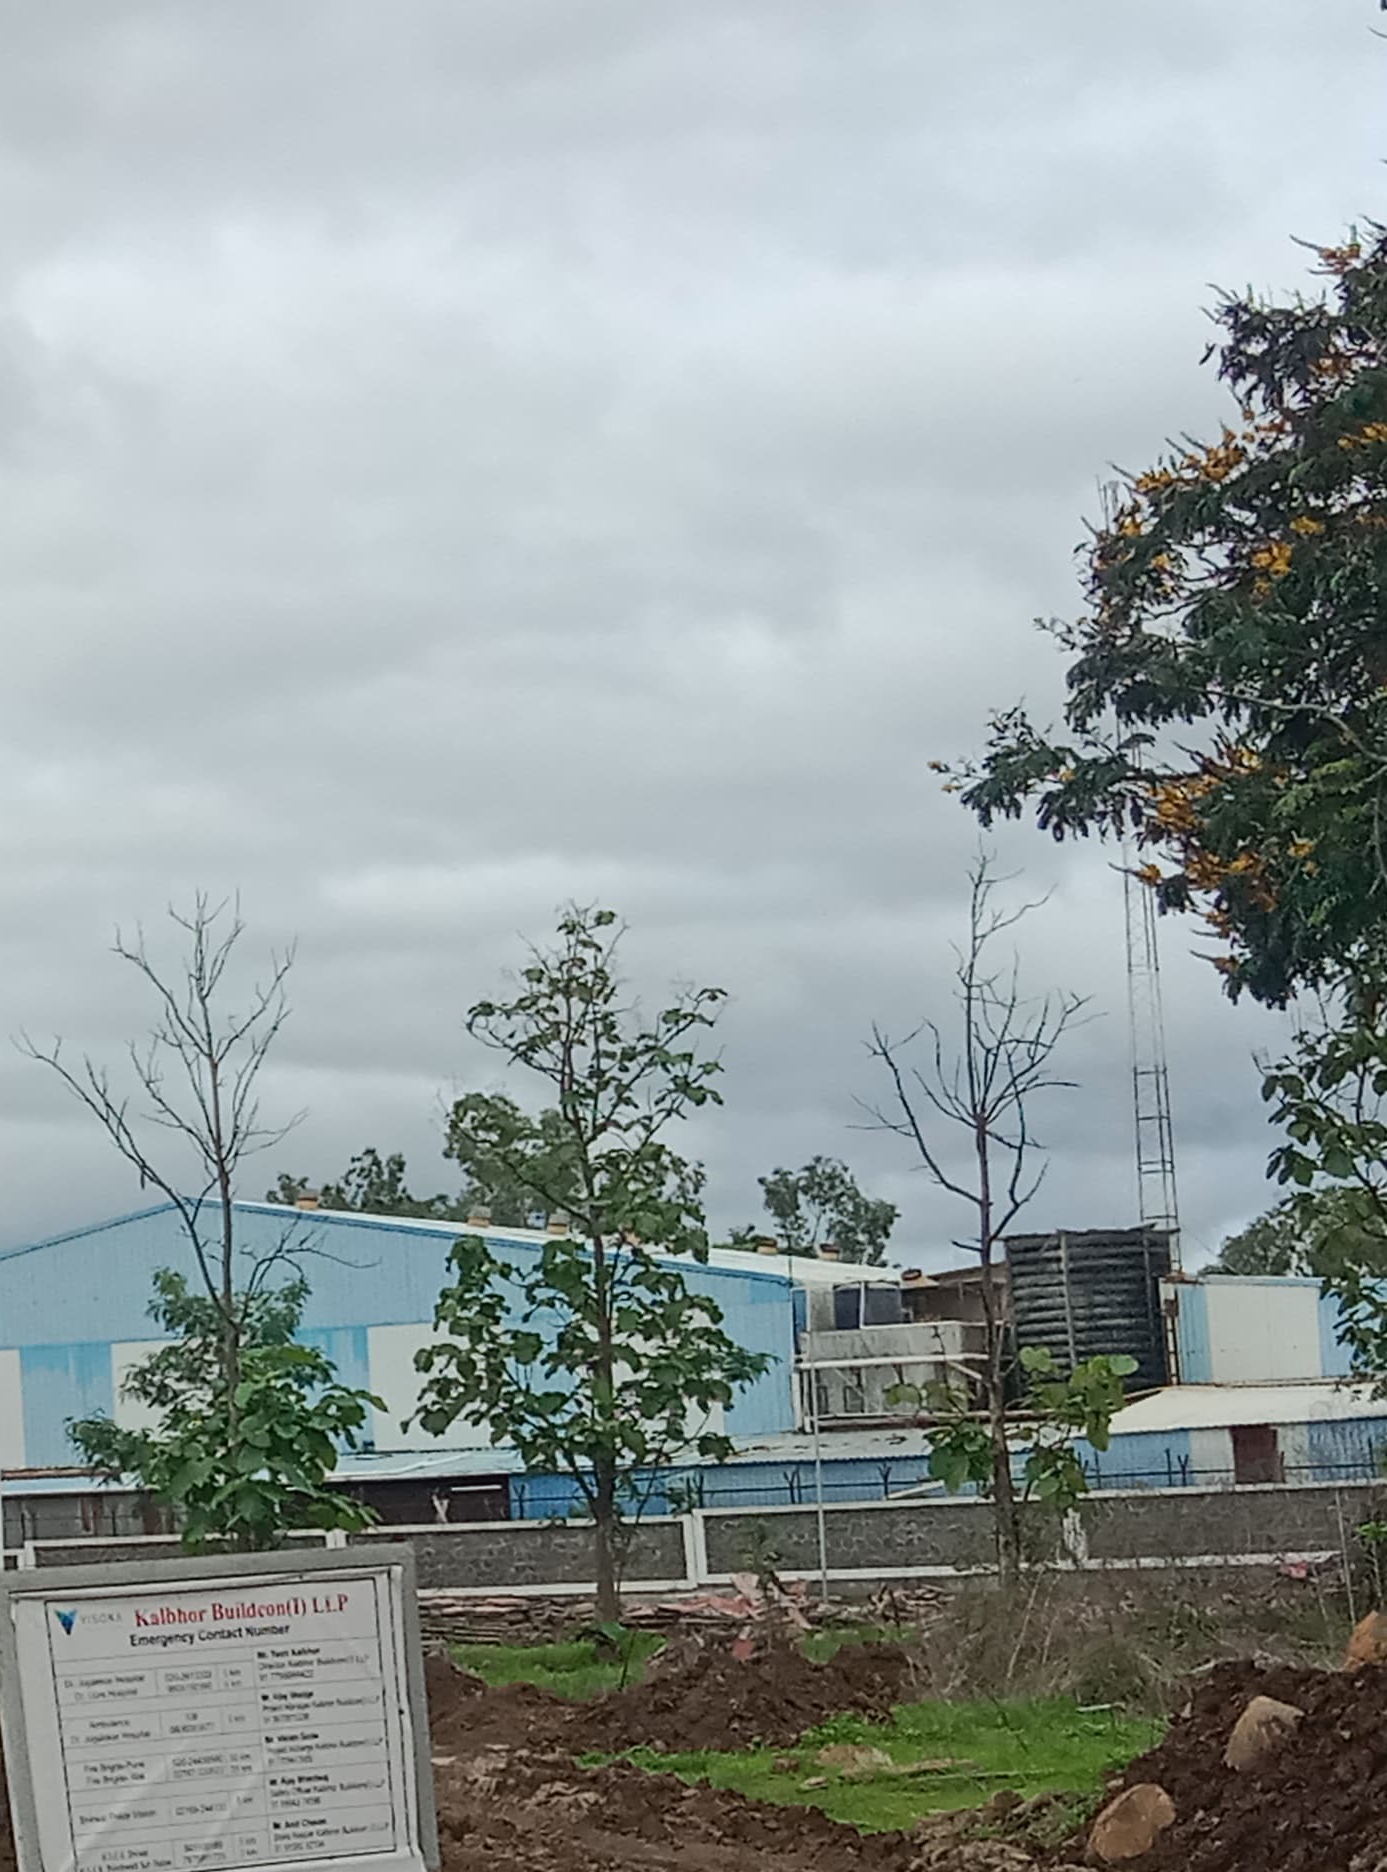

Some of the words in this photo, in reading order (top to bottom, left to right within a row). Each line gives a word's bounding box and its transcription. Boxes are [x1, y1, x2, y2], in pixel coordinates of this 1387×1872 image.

[134, 1605, 206, 1628] Kalbhor
[211, 1597, 307, 1623] Buildcon(I)
[312, 1594, 349, 1615] LLP
[129, 1629, 195, 1648] Emergency
[198, 1626, 243, 1643] Contact
[245, 1623, 291, 1638] Number
